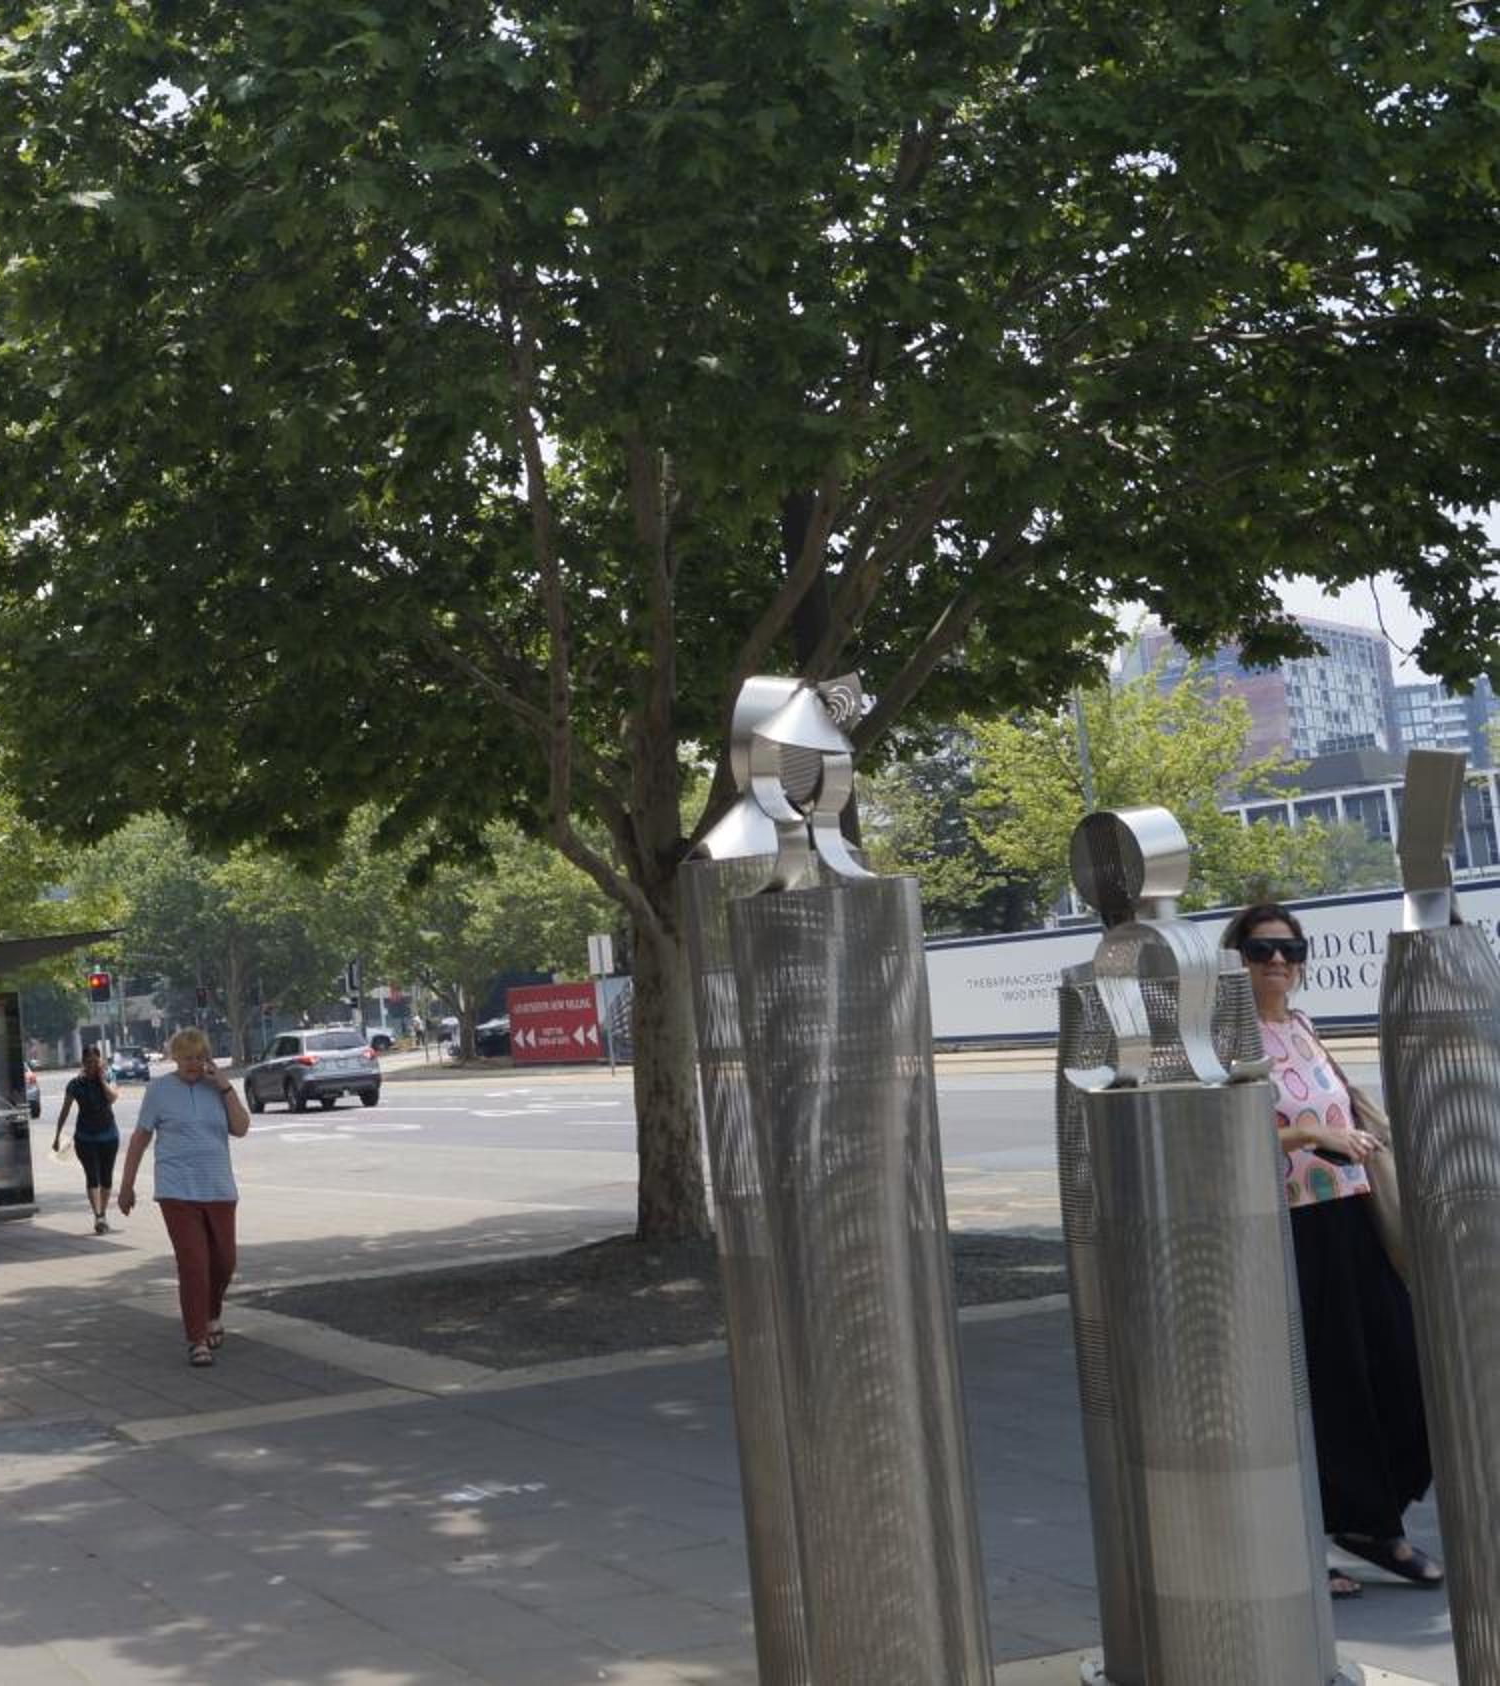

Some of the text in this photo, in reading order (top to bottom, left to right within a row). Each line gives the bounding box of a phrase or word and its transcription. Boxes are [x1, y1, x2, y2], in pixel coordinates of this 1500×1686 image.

[1309, 930, 1384, 960] LD CL
[1360, 962, 1379, 989] C
